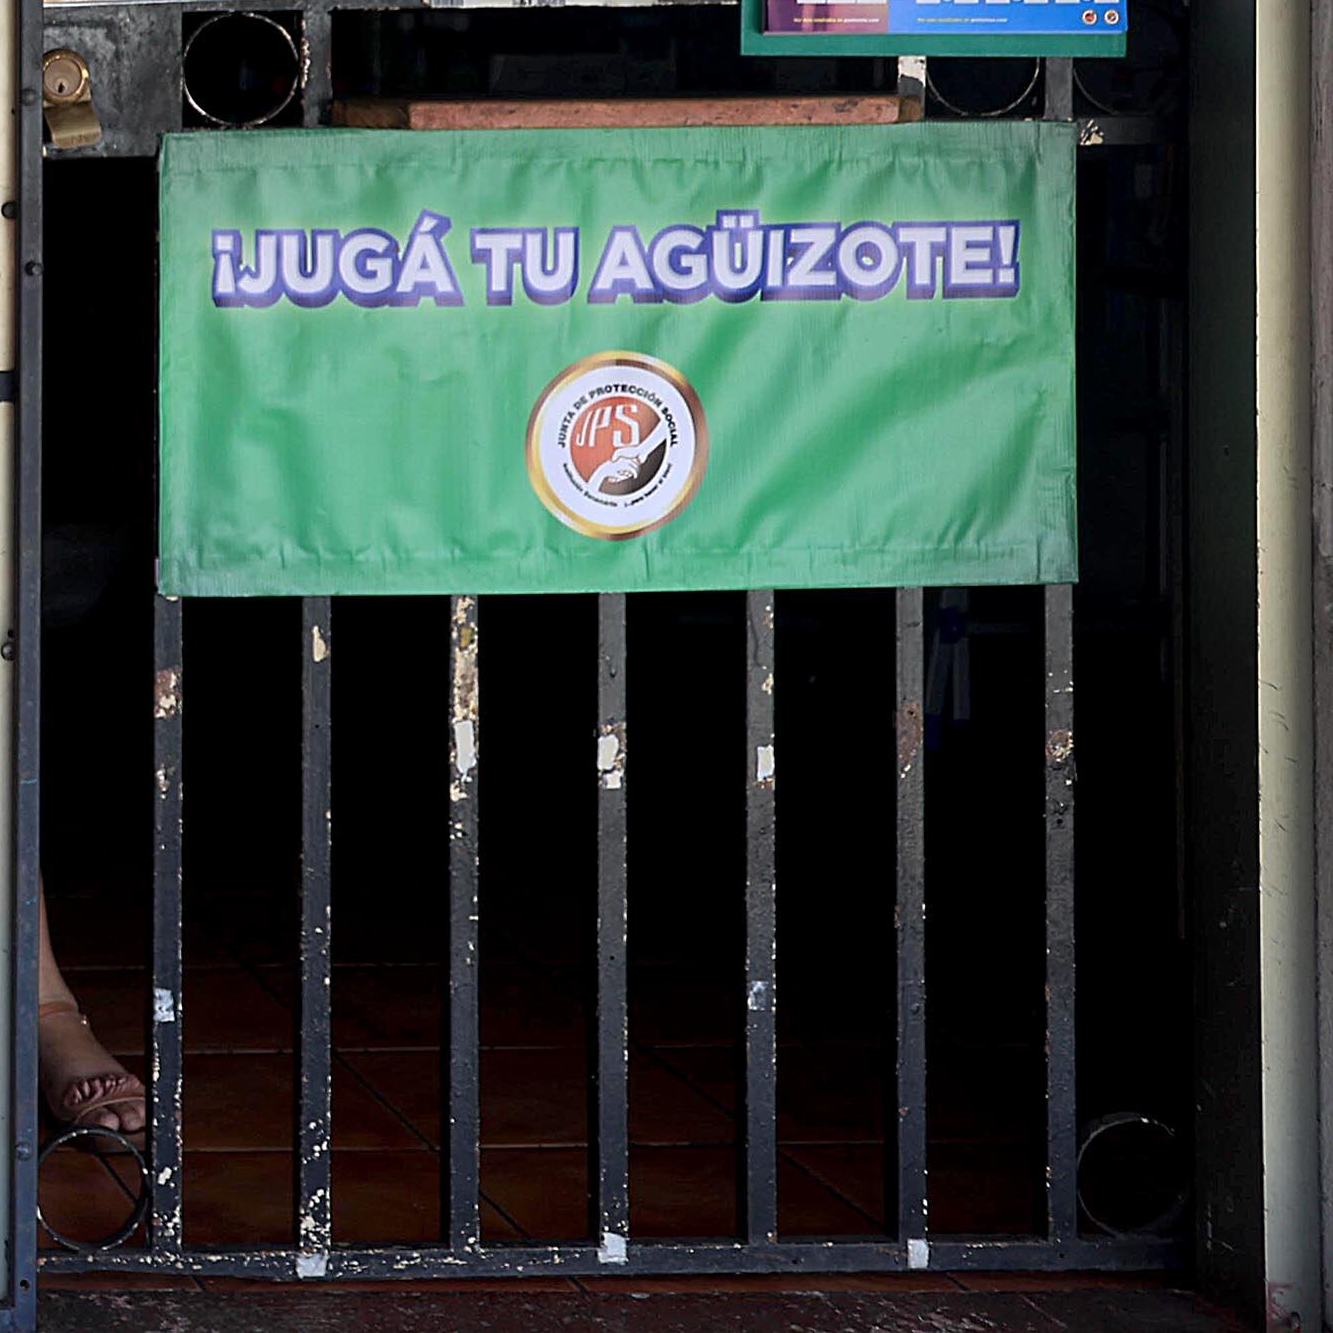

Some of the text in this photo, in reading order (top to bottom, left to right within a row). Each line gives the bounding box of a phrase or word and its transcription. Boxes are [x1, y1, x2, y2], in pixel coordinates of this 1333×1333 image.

[211, 208, 1022, 309] ¡JUGÁ TU AGÜIZOTE!
[558, 384, 678, 448] JUNTA DE PROTECCIÓN SOCIAL
